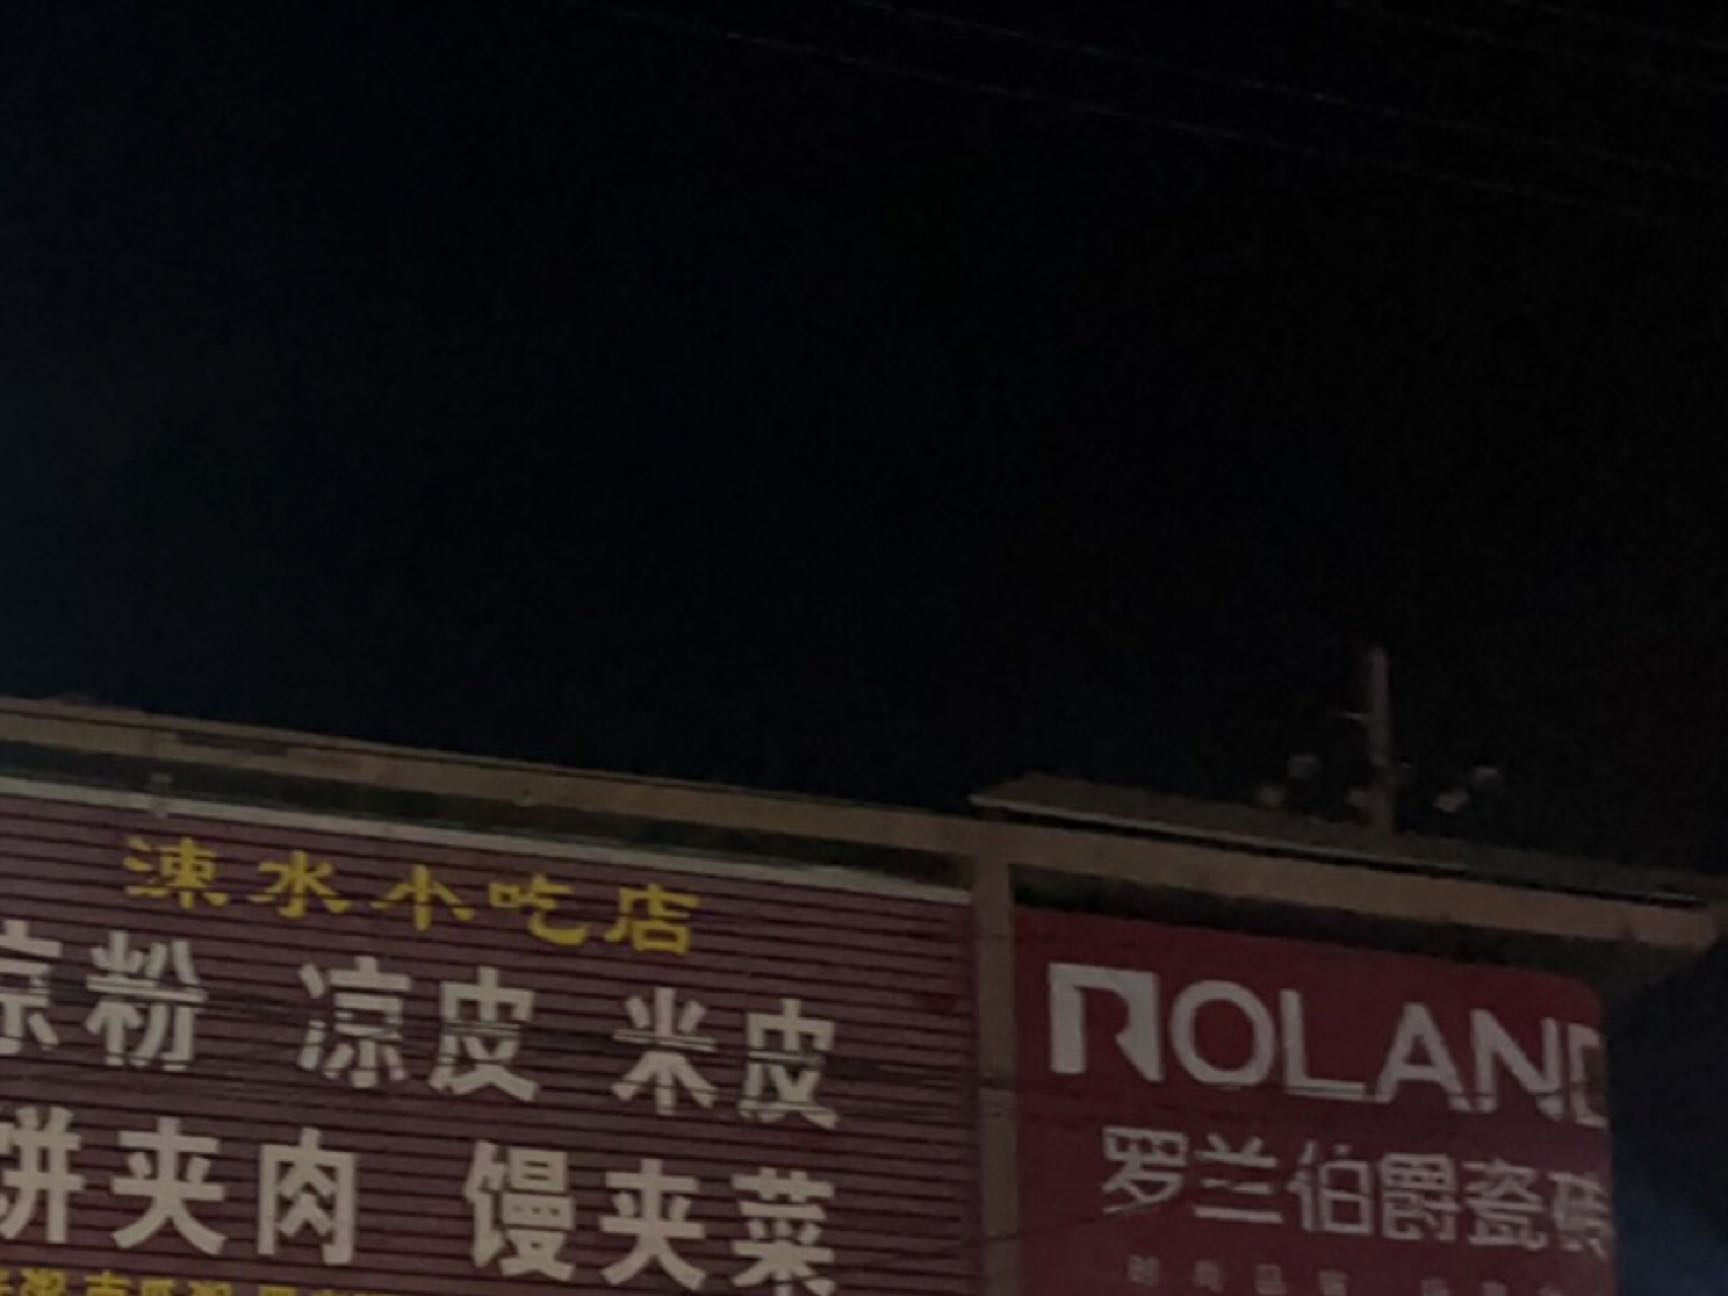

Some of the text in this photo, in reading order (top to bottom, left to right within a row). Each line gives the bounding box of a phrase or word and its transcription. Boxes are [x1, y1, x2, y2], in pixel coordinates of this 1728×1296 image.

[297, 955, 539, 1102] 凉皮
[610, 986, 839, 1130] 米皮
[1102, 1126, 1610, 1259] 罗兰伯爵瓷砖
